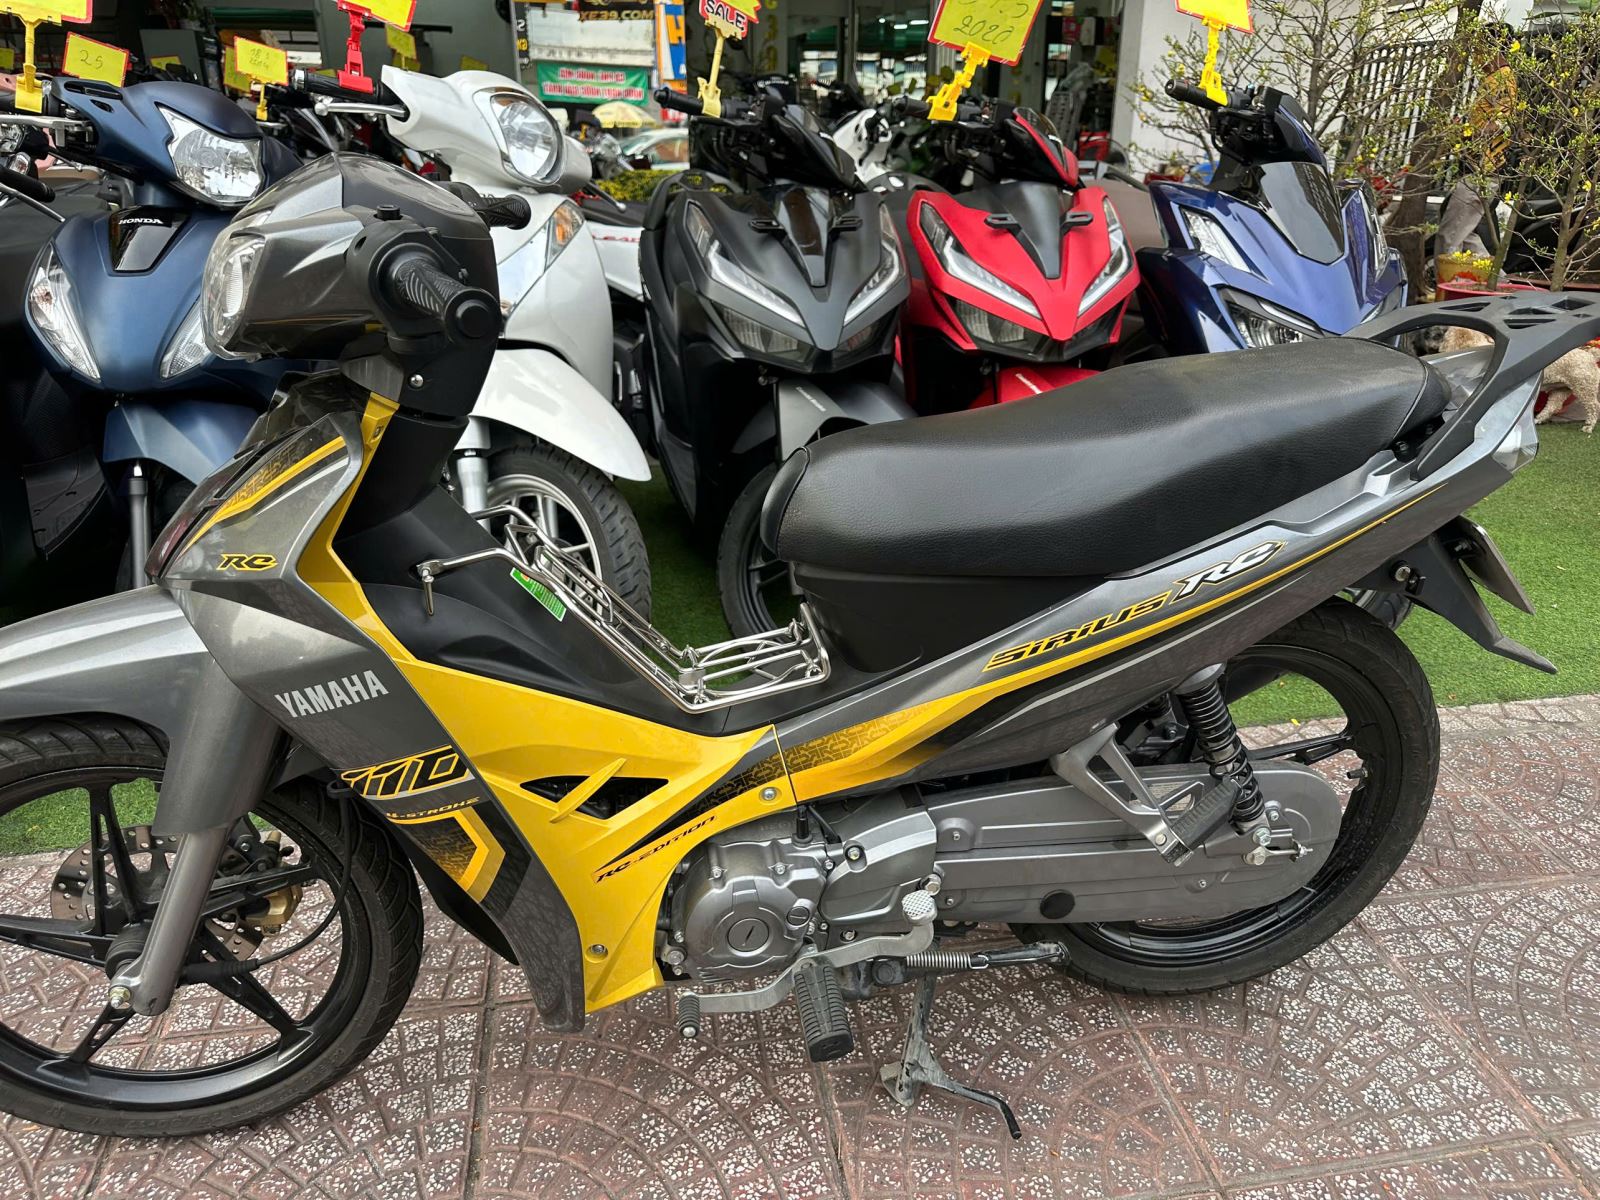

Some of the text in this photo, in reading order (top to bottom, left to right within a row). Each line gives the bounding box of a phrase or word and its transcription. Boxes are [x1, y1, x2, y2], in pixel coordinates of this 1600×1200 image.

[580, 9, 655, 21] XE39.COM
[705, 0, 745, 32] SALE
[953, 15, 1015, 45] 2020
[118, 217, 164, 225] HONDA
[216, 554, 278, 571] RC
[982, 540, 1287, 672] SIRIUS RC
[273, 670, 389, 718] YAMAHA
